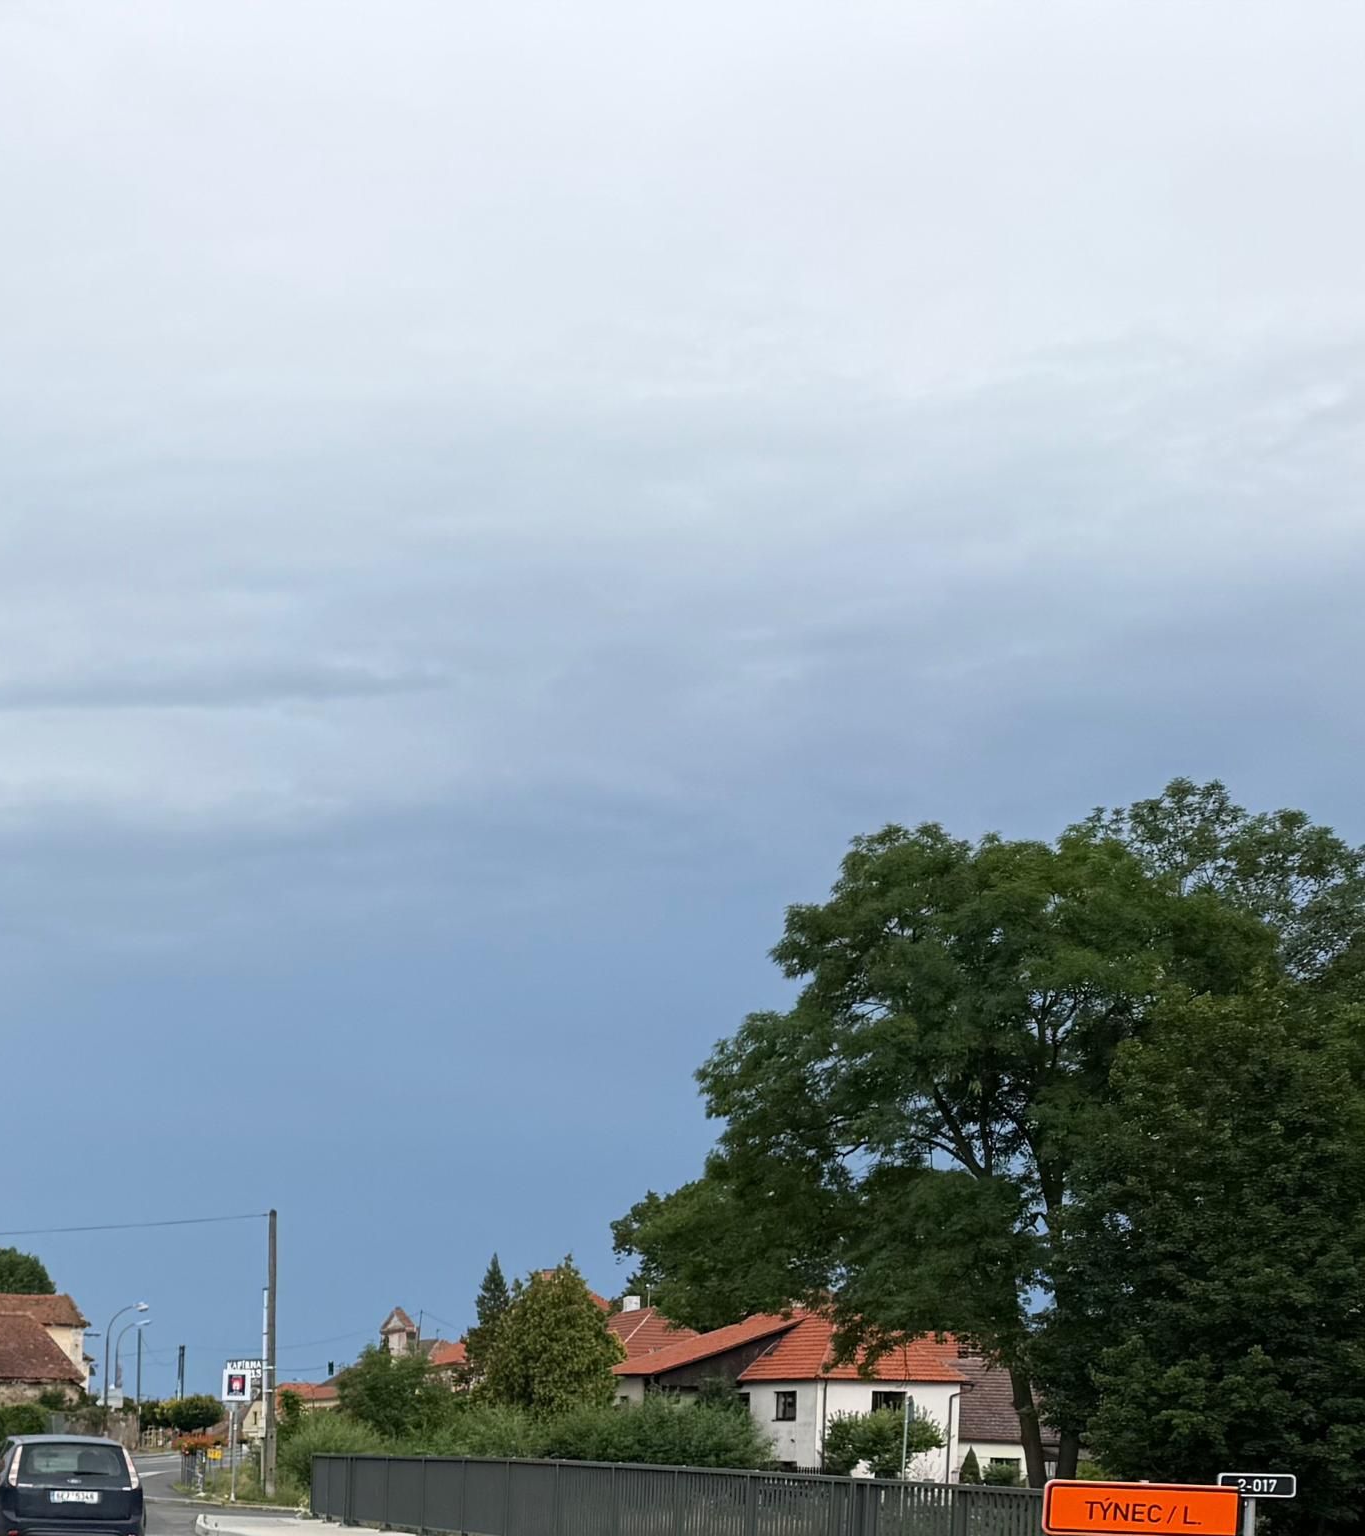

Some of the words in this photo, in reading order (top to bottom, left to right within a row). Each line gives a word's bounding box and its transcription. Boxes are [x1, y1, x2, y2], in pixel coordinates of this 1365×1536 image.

[1238, 1478, 1277, 1493] 2-017
[1084, 1497, 1163, 1523] TÝNEC
[1183, 1505, 1202, 1525] L.
